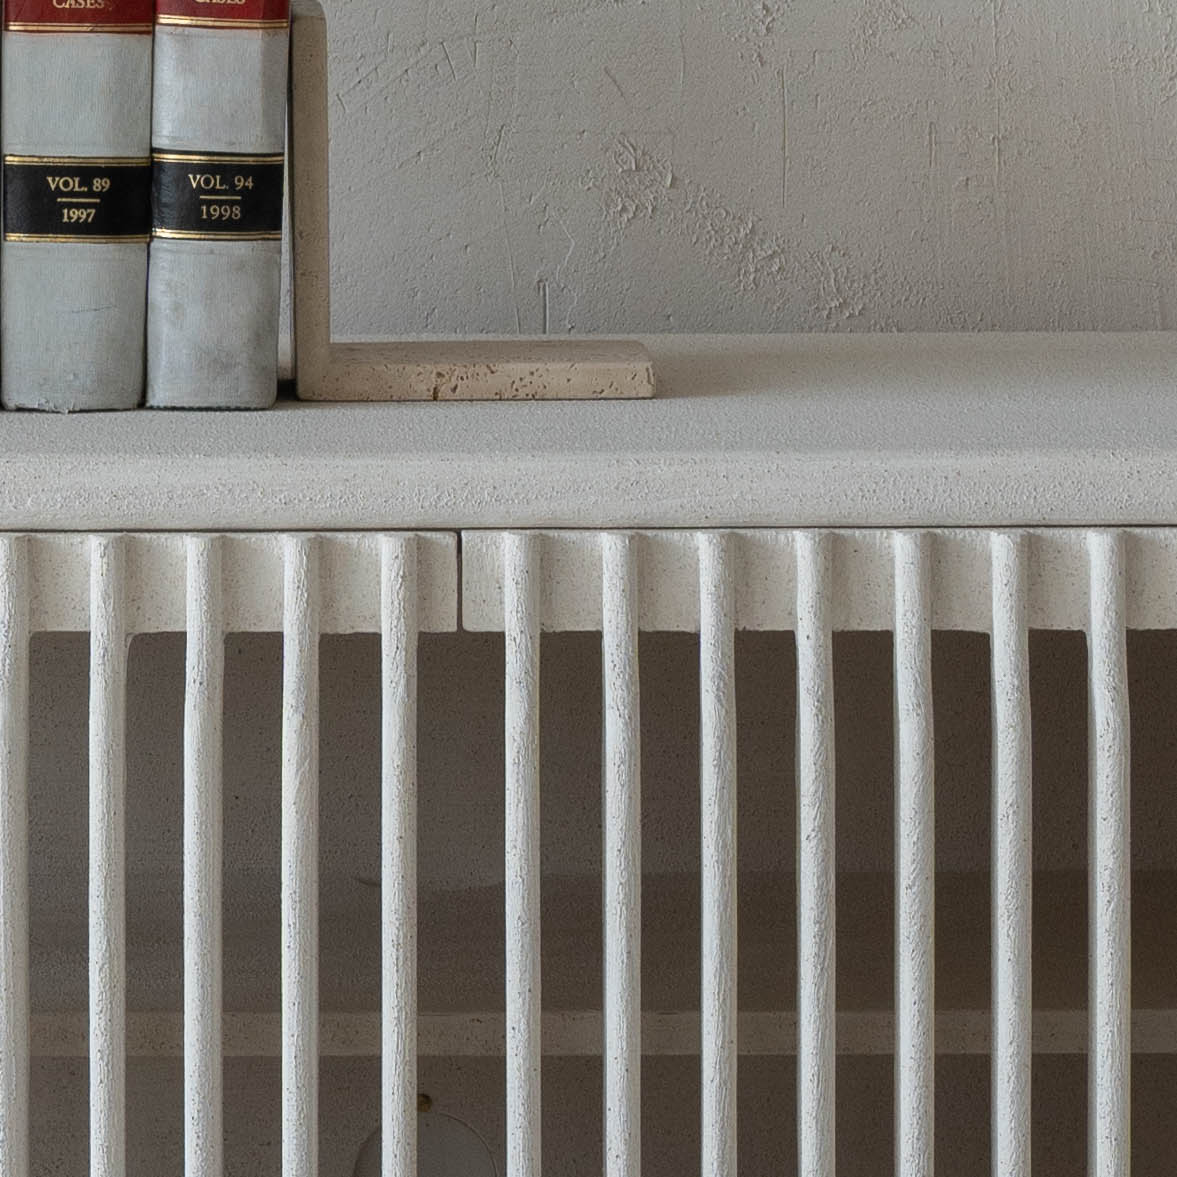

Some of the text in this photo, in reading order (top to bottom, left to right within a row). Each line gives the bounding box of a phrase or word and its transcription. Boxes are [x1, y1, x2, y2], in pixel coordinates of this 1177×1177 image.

[46, 176, 111, 192] VOL. 89
[188, 174, 254, 191] VOL. 94
[61, 207, 96, 224] 1997
[200, 204, 241, 220] 1998
